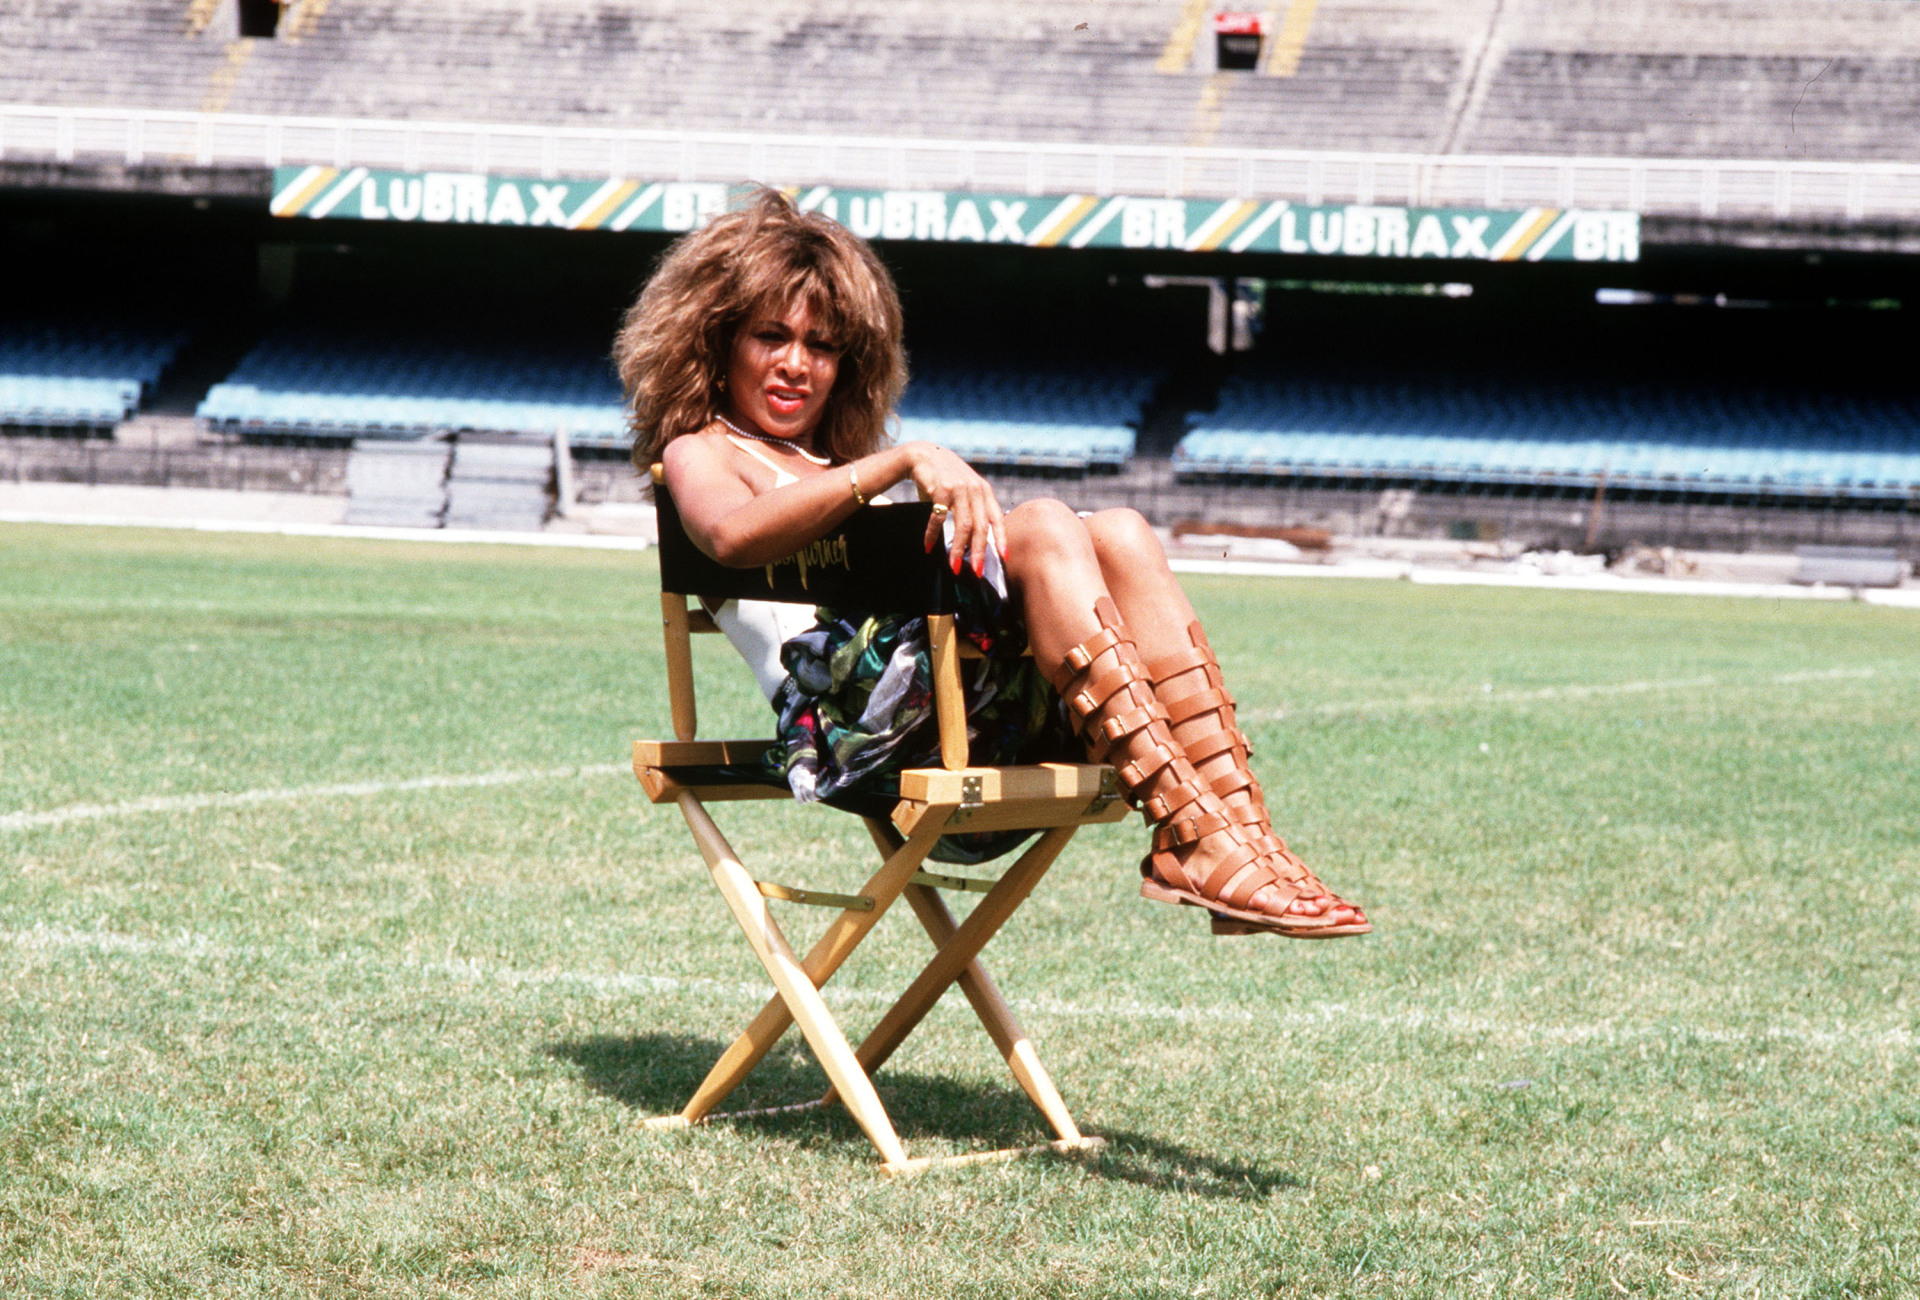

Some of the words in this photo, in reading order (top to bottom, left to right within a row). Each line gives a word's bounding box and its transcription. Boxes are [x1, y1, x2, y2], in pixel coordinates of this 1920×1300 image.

[361, 173, 569, 226] LUBRAX
[1121, 199, 1186, 248] BR
[1279, 206, 1491, 257] LUBRAX
[1572, 210, 1640, 261] BR
